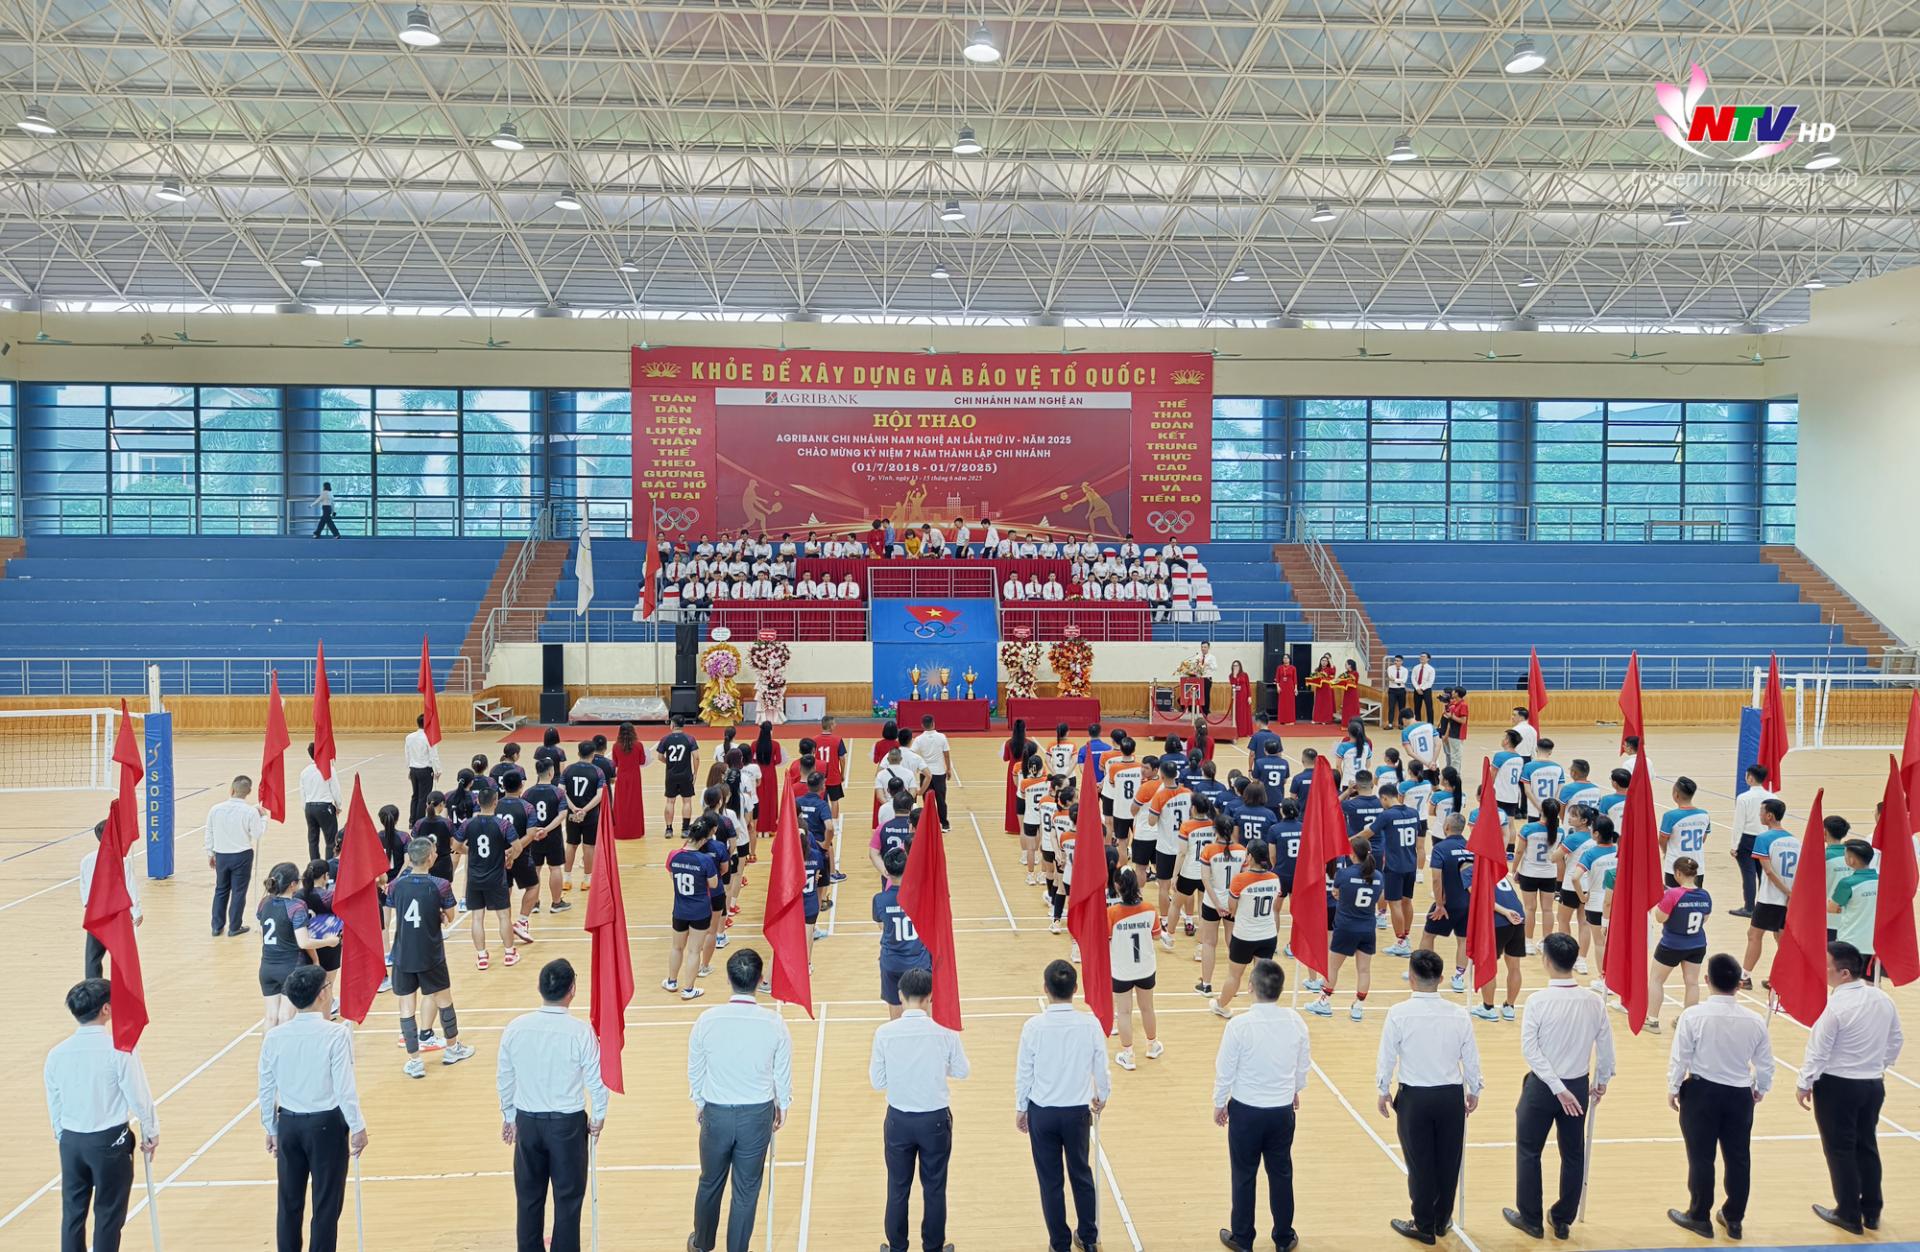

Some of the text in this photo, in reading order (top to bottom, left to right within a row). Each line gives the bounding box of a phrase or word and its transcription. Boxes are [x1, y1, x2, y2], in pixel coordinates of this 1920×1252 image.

[692, 357, 752, 381] KHỎE
[762, 357, 791, 382] ĐỂ
[800, 362, 844, 384] XÂY
[854, 365, 916, 388] DỰNG
[925, 365, 953, 386] VÀ
[962, 362, 1006, 386] BẢO
[1016, 365, 1041, 389] VỆ
[1050, 361, 1077, 386] TỔ
[649, 393, 696, 402] TOÀN
[780, 392, 859, 405] AGRIBANK
[954, 395, 1083, 406] CHI NHÁNH NAM NGHỆ AN
[655, 404, 692, 413] DÂN
[873, 410, 976, 431] HỘI THAO
[1150, 421, 1193, 429] ĐOÀN
[645, 426, 702, 436] LUYỆN
[1158, 430, 1186, 439] KẾT
[650, 437, 697, 445] THÂN
[776, 434, 829, 443] AGRIBANK
[832, 435, 850, 443] CHI
[853, 434, 888, 443] NHÁNH
[891, 435, 914, 444] NAM
[917, 434, 944, 446] NGHỆ
[947, 436, 960, 444] AN
[1005, 436, 1015, 444] IV
[1023, 434, 1045, 444] NĂM
[1048, 436, 1071, 444] 2025
[797, 446, 828, 456] CHÀO
[830, 446, 861, 457] MỪNG
[879, 447, 903, 460] NIỆM
[914, 448, 936, 458] NĂM
[939, 448, 972, 458] THÀNH
[975, 448, 992, 460] LẬP
[995, 450, 1012, 458] CHI
[1015, 447, 1051, 458] NHÁNH
[1152, 453, 1191, 462] THỰC
[651, 459, 696, 467] THEO
[852, 462, 919, 473] (01/7/2018
[930, 463, 997, 473] 01/7/2025)
[643, 469, 705, 477] GƯƠNG
[670, 491, 700, 500] ĐẠI
[1140, 493, 1201, 504] TIẾN BỘ
[802, 703, 808, 712] 1
[1418, 736, 1428, 752] 9
[668, 745, 686, 762] 27
[818, 746, 830, 762] 11
[1056, 753, 1065, 768] 3
[572, 776, 589, 797] 17
[1268, 771, 1281, 786] 9
[1123, 780, 1134, 799] 8
[1537, 779, 1554, 798] 21
[149, 771, 160, 842] SODEX
[536, 801, 547, 821] 8
[1043, 813, 1052, 832] 9
[1173, 810, 1183, 831] 3
[1244, 823, 1262, 839] 85
[1397, 827, 1416, 847] 18
[477, 834, 490, 858] 8
[1537, 844, 1549, 862] 2
[1779, 851, 1798, 878] 12
[674, 872, 695, 896] 18
[1355, 887, 1374, 907] 6
[404, 898, 421, 928] 4
[1253, 895, 1274, 918] 10
[892, 914, 919, 941] 10
[1686, 911, 1703, 934] 9
[263, 918, 277, 945] 2
[1130, 933, 1140, 963] 1
